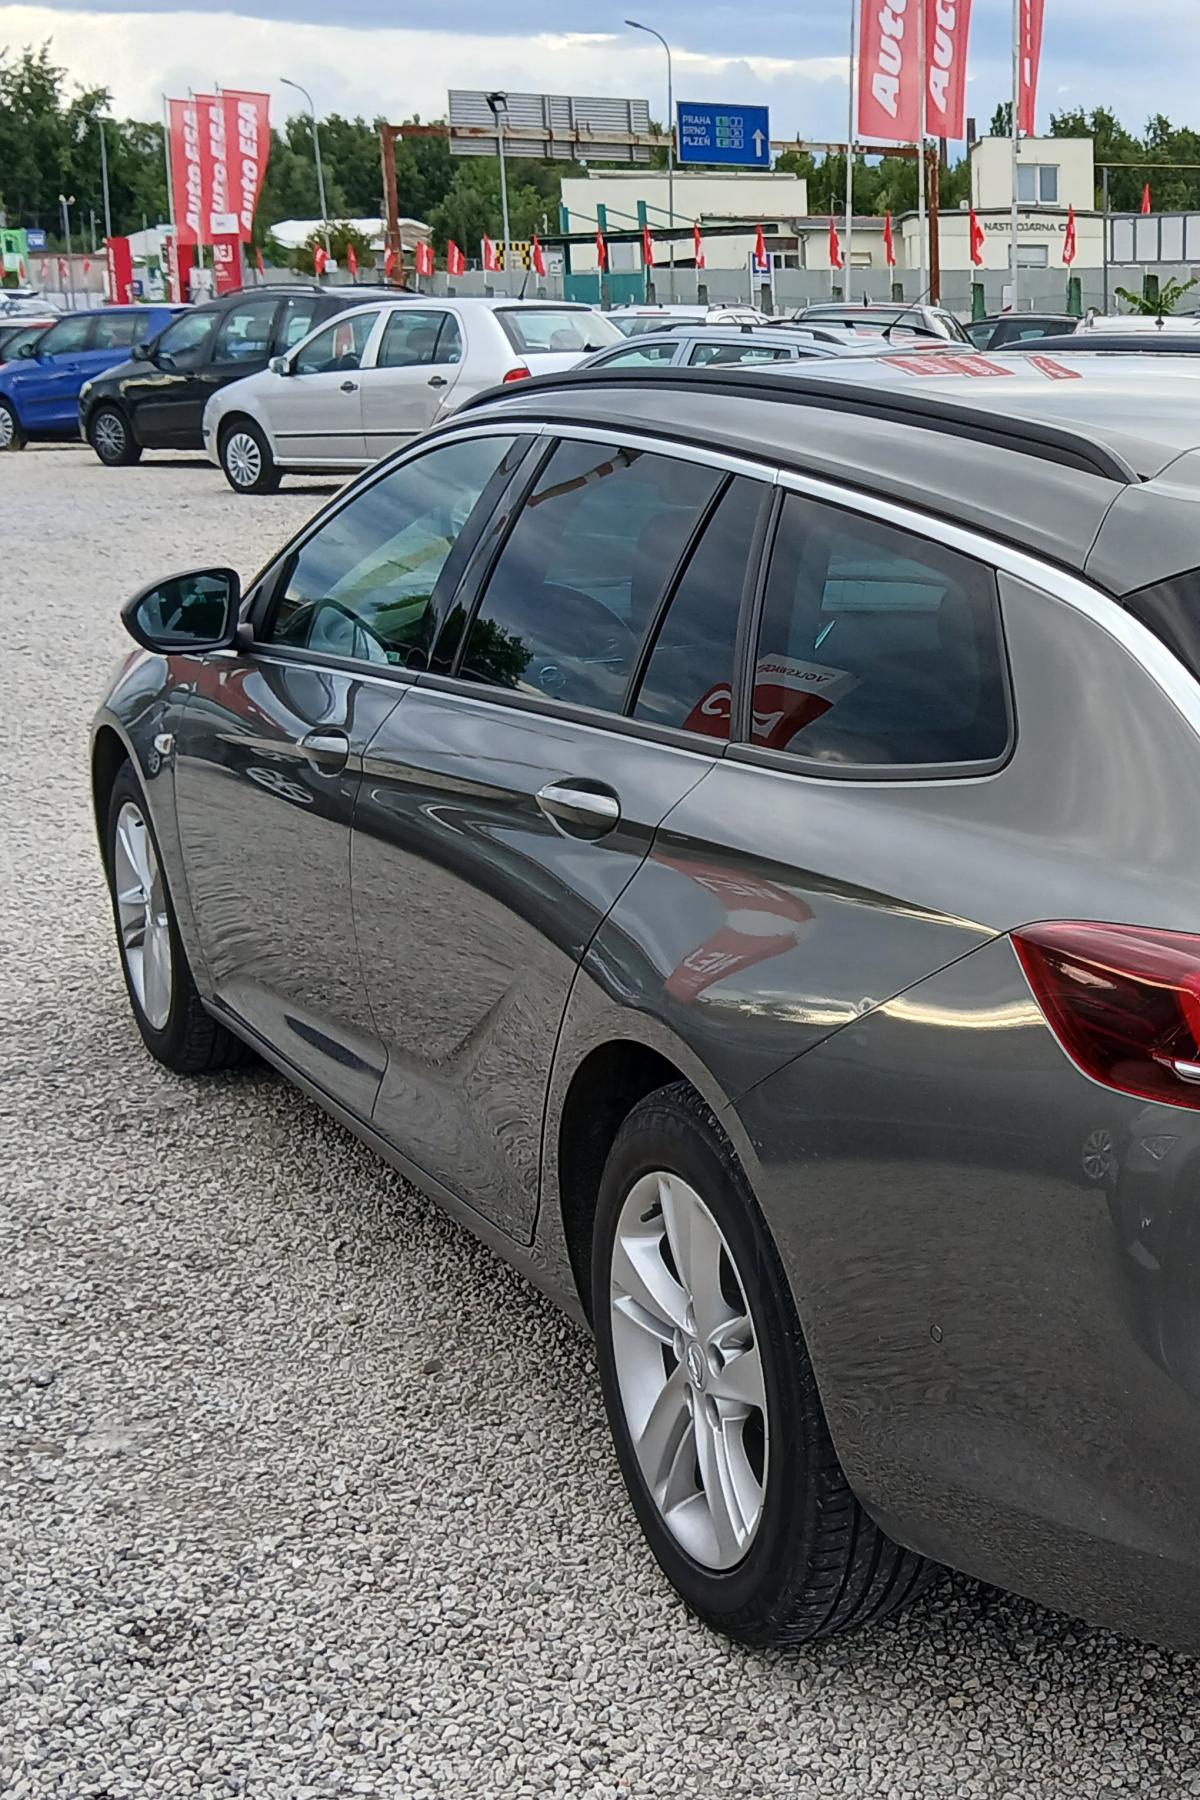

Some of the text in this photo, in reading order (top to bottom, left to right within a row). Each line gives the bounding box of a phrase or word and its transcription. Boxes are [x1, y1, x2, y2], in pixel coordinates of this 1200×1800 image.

[929, 0, 957, 114] Aut
[682, 115, 711, 125] PRAHA
[238, 101, 258, 159] ESA
[682, 126, 706, 135] BRNO
[682, 135, 711, 146] PLZEŇ
